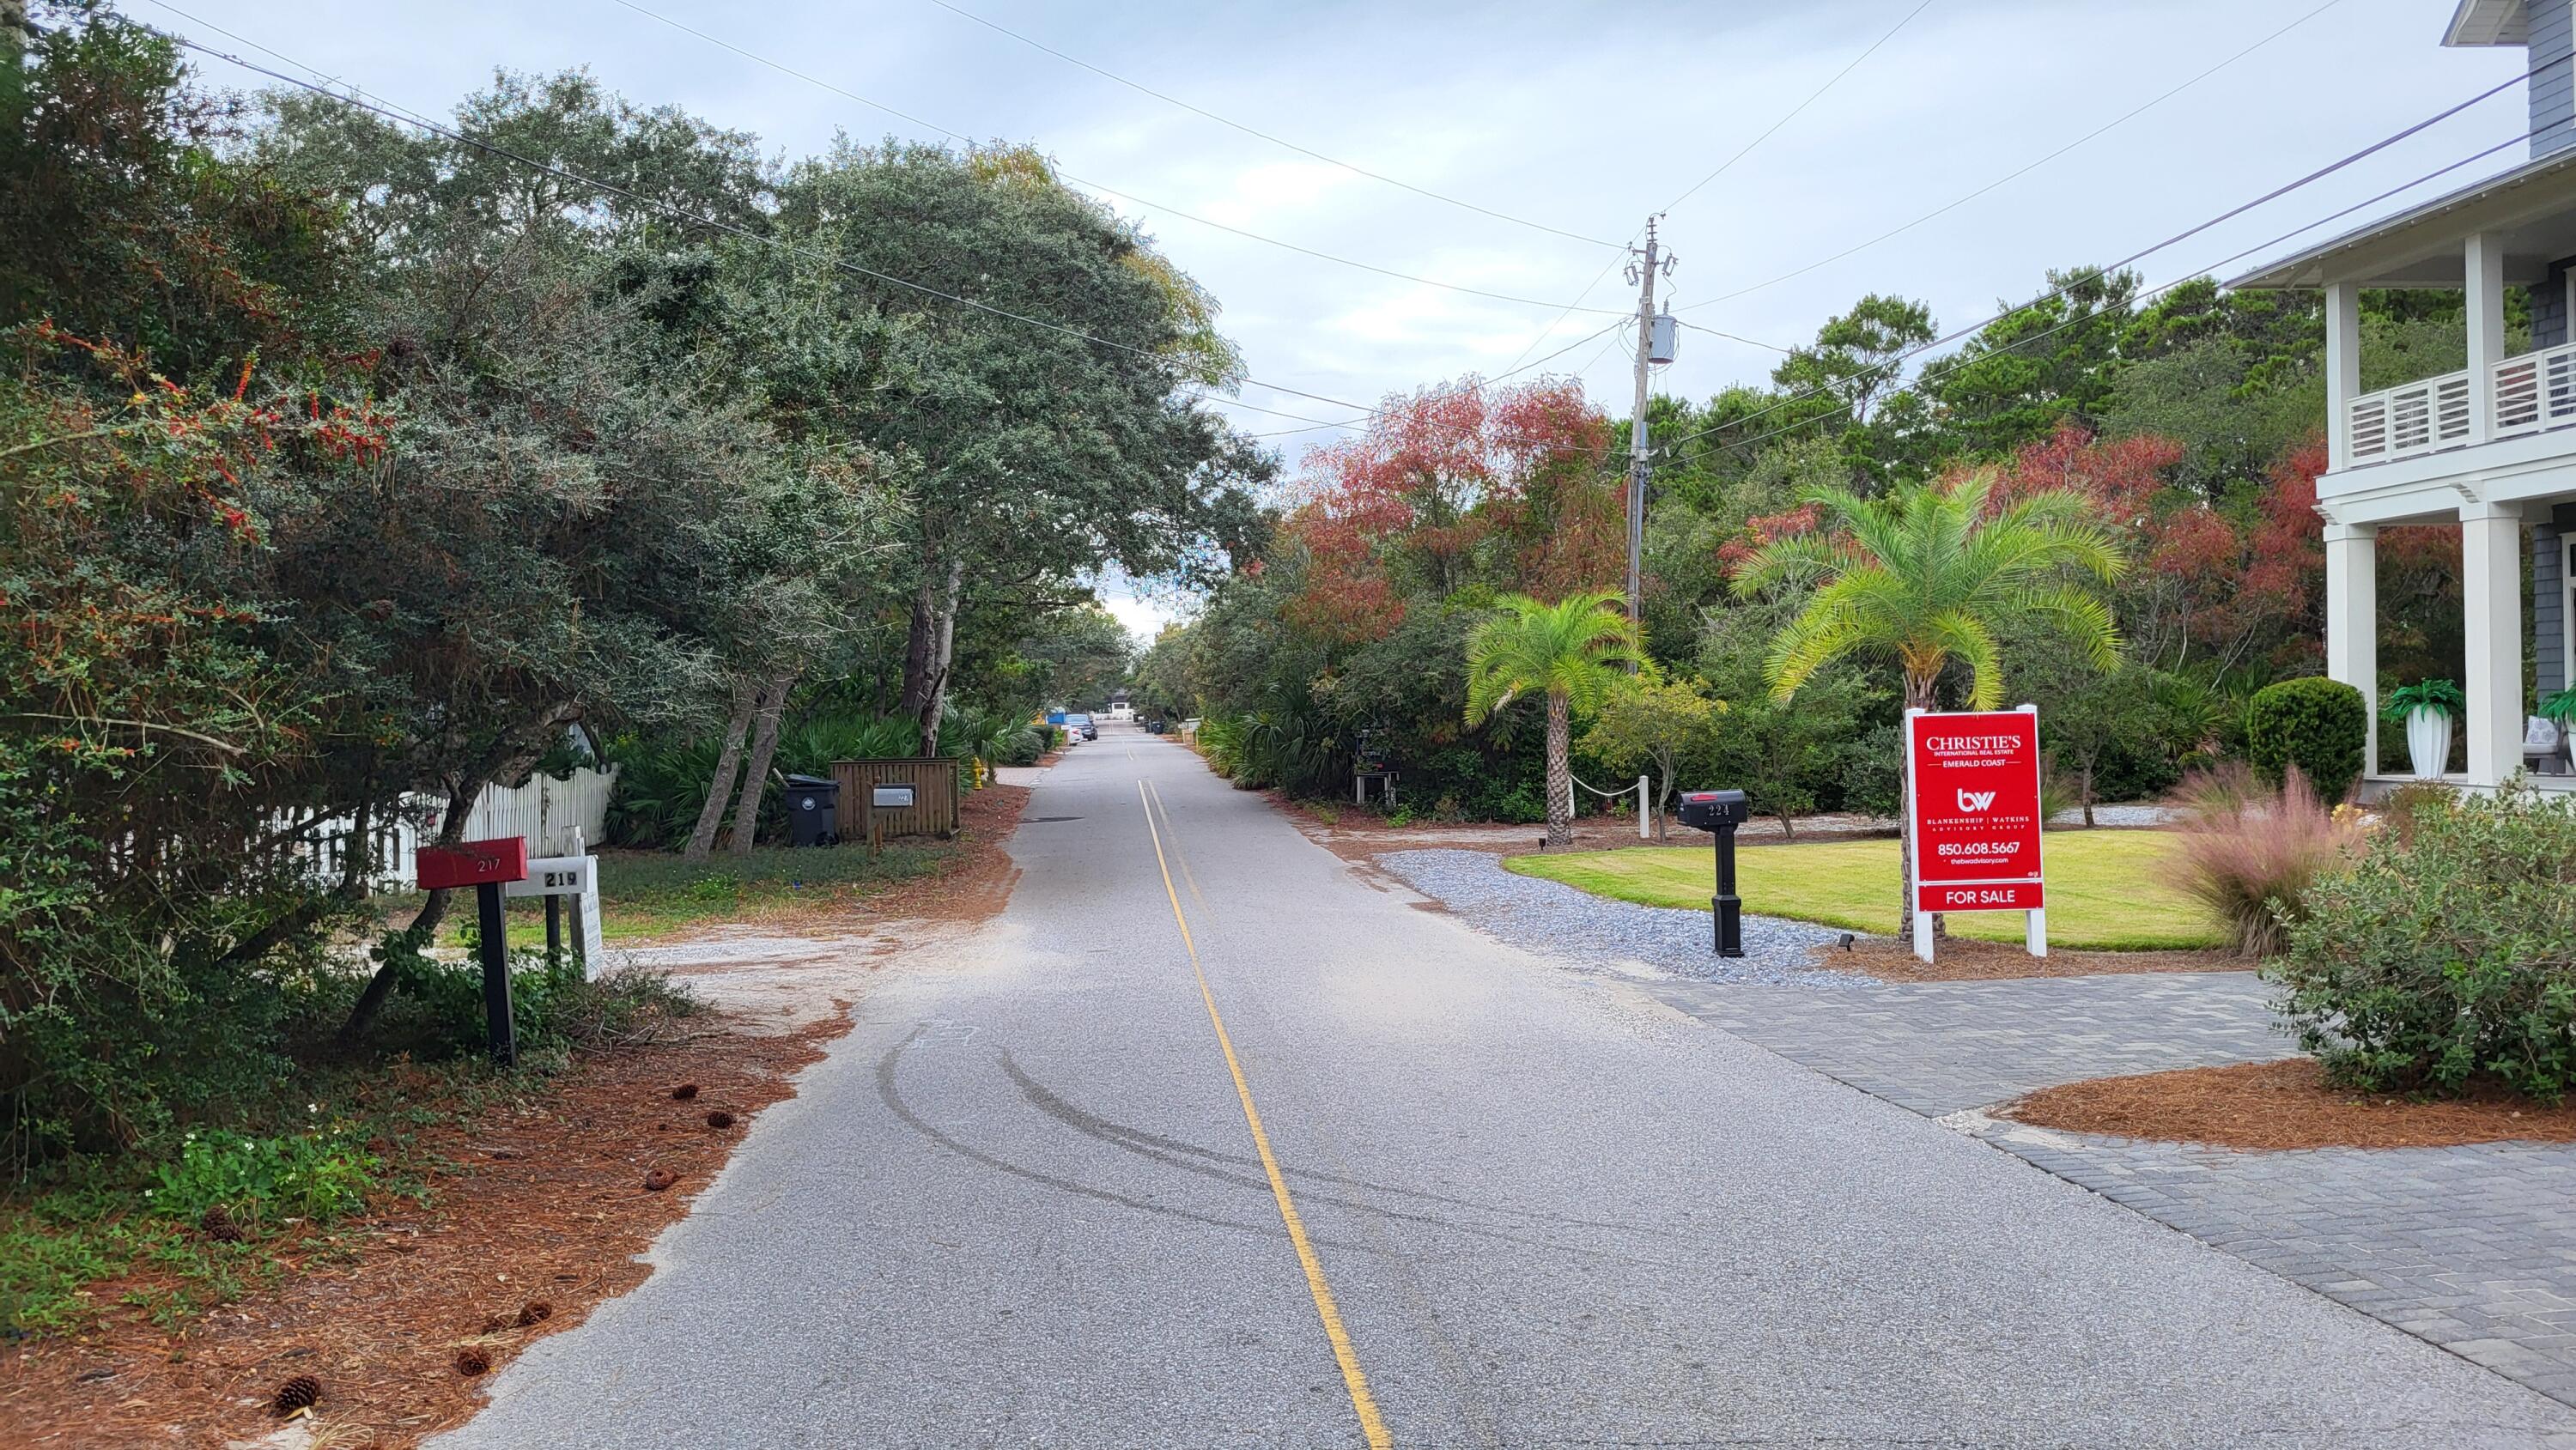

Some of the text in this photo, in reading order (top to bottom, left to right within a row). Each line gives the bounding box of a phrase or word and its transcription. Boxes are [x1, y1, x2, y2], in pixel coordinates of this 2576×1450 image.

[1926, 735, 2020, 750] CHRISTIE'S
[1709, 804, 1730, 816] 224
[1938, 841, 2020, 855] 850.608.5667
[477, 858, 501, 872] 217
[545, 872, 577, 888] 219
[1946, 889, 2016, 904] FOR SALE
